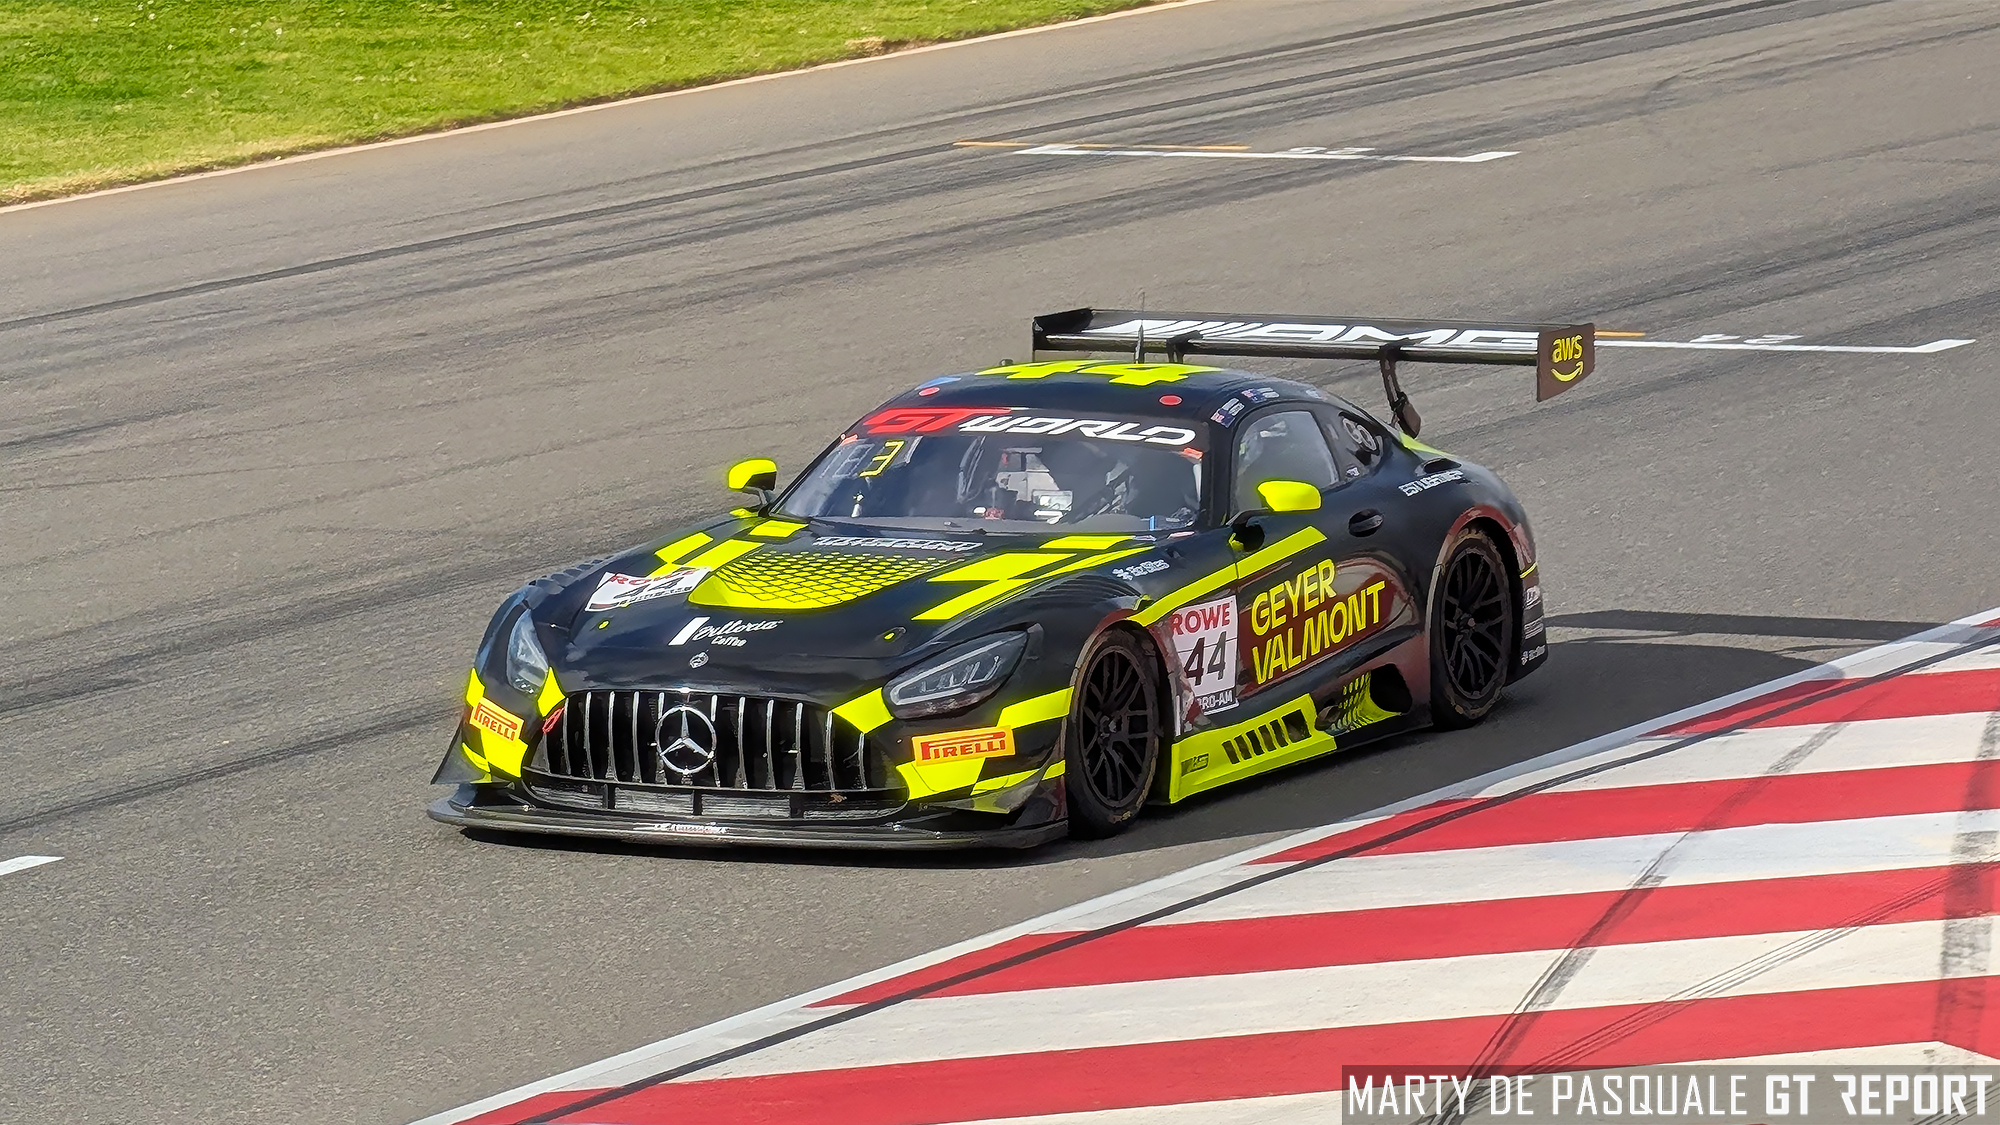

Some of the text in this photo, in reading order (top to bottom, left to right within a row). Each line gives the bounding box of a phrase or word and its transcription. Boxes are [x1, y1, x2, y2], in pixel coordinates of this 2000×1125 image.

[1215, 322, 1539, 348] AMG
[1552, 333, 1583, 363] aws
[975, 359, 1226, 386] 44
[863, 407, 1196, 445] GT WORLD
[860, 441, 905, 477] 3
[1252, 558, 1336, 636] GEYER
[1171, 602, 1231, 636] ROWE
[1251, 580, 1386, 685] VALMONT
[1184, 631, 1226, 686] 44
[474, 702, 518, 741] PIRELLI
[920, 731, 1006, 760] PIRELLI
